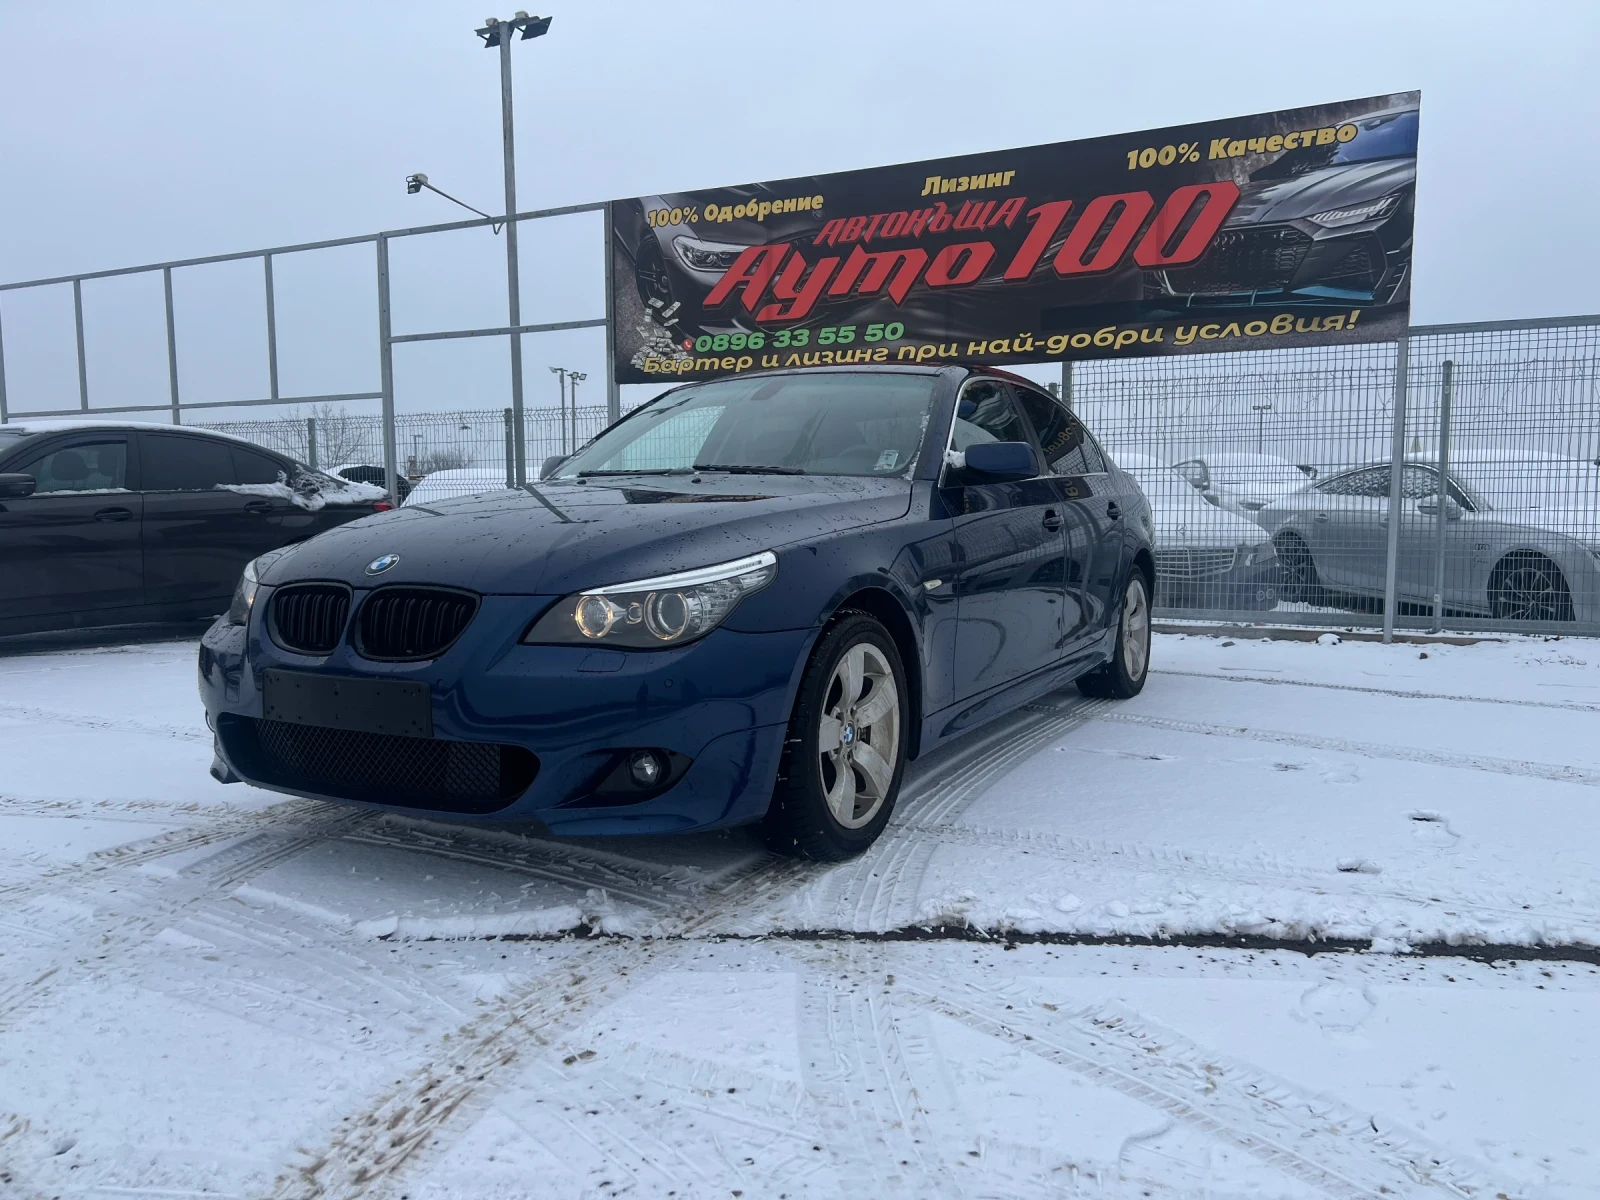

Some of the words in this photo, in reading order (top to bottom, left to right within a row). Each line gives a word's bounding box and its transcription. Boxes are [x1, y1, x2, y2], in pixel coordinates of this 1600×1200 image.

[1127, 141, 1200, 170] 100%
[1208, 124, 1358, 160] Качество
[921, 170, 1015, 196] Лизинг
[648, 207, 699, 228] 100%
[703, 195, 824, 224] Одобрение
[1001, 180, 1241, 284] 100
[643, 356, 753, 375] Бартер
[761, 354, 779, 368] и
[785, 347, 889, 367] лизинг
[898, 340, 958, 363] при
[966, 325, 1164, 355] най-добри
[1173, 309, 1361, 346] условия!
[695, 332, 765, 352] 0896
[772, 328, 810, 348] 33
[817, 325, 857, 345] 55
[864, 321, 905, 343] 50
